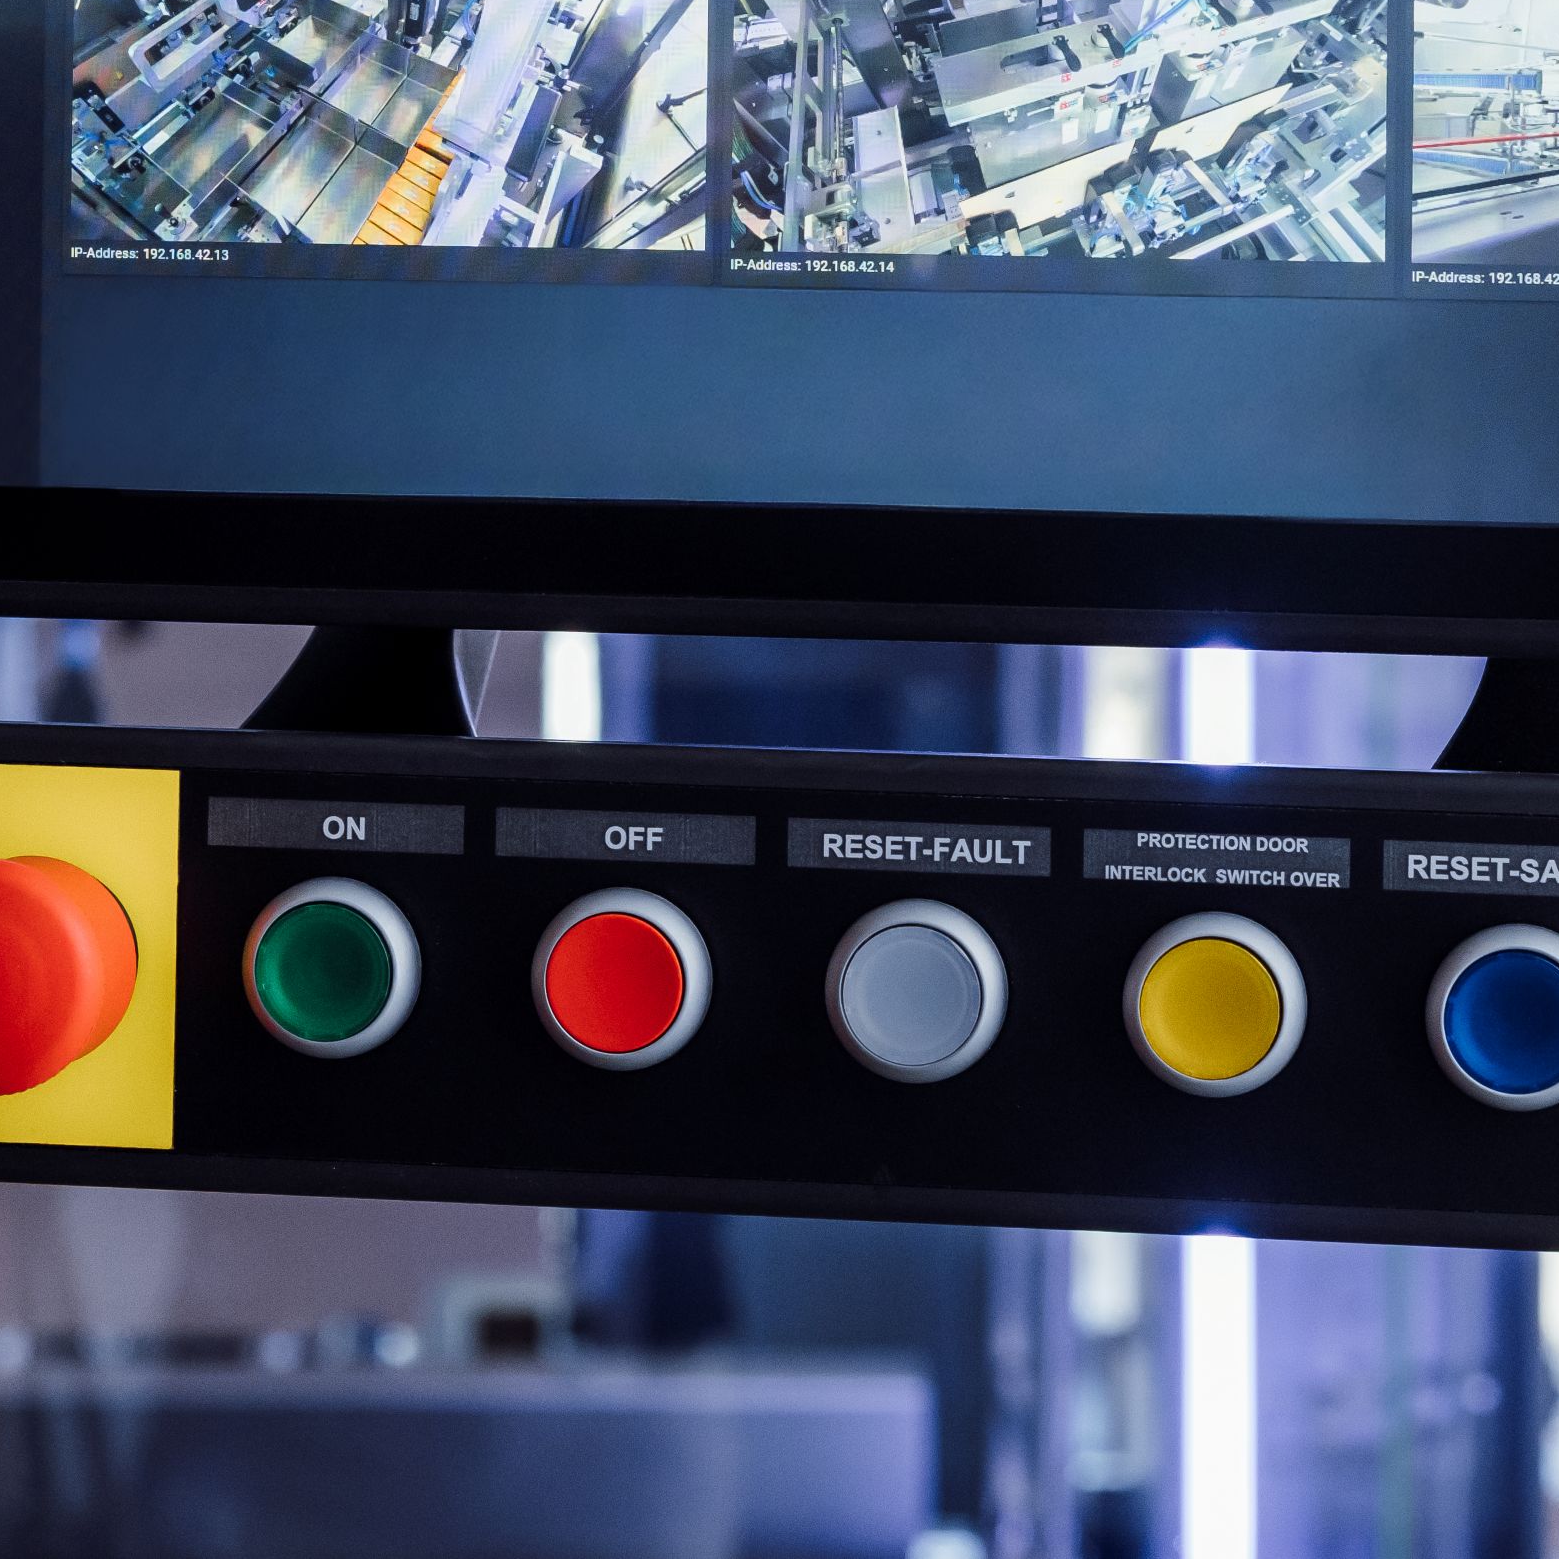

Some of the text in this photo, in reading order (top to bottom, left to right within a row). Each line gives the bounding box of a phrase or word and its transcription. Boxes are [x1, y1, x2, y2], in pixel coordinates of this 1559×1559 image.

[70, 247, 229, 260] IP-Address: 192.168.42.13
[730, 259, 895, 273] IP-Address: 192.168.42.14
[1412, 271, 1485, 283] IP-Address:
[322, 815, 366, 841] ON
[604, 825, 663, 852] OFF
[822, 833, 1031, 865] RESET-FAULT
[1136, 832, 1309, 854] PROTECTION DOOR
[1104, 864, 1340, 888] INTERLOCK SWITCH OVER
